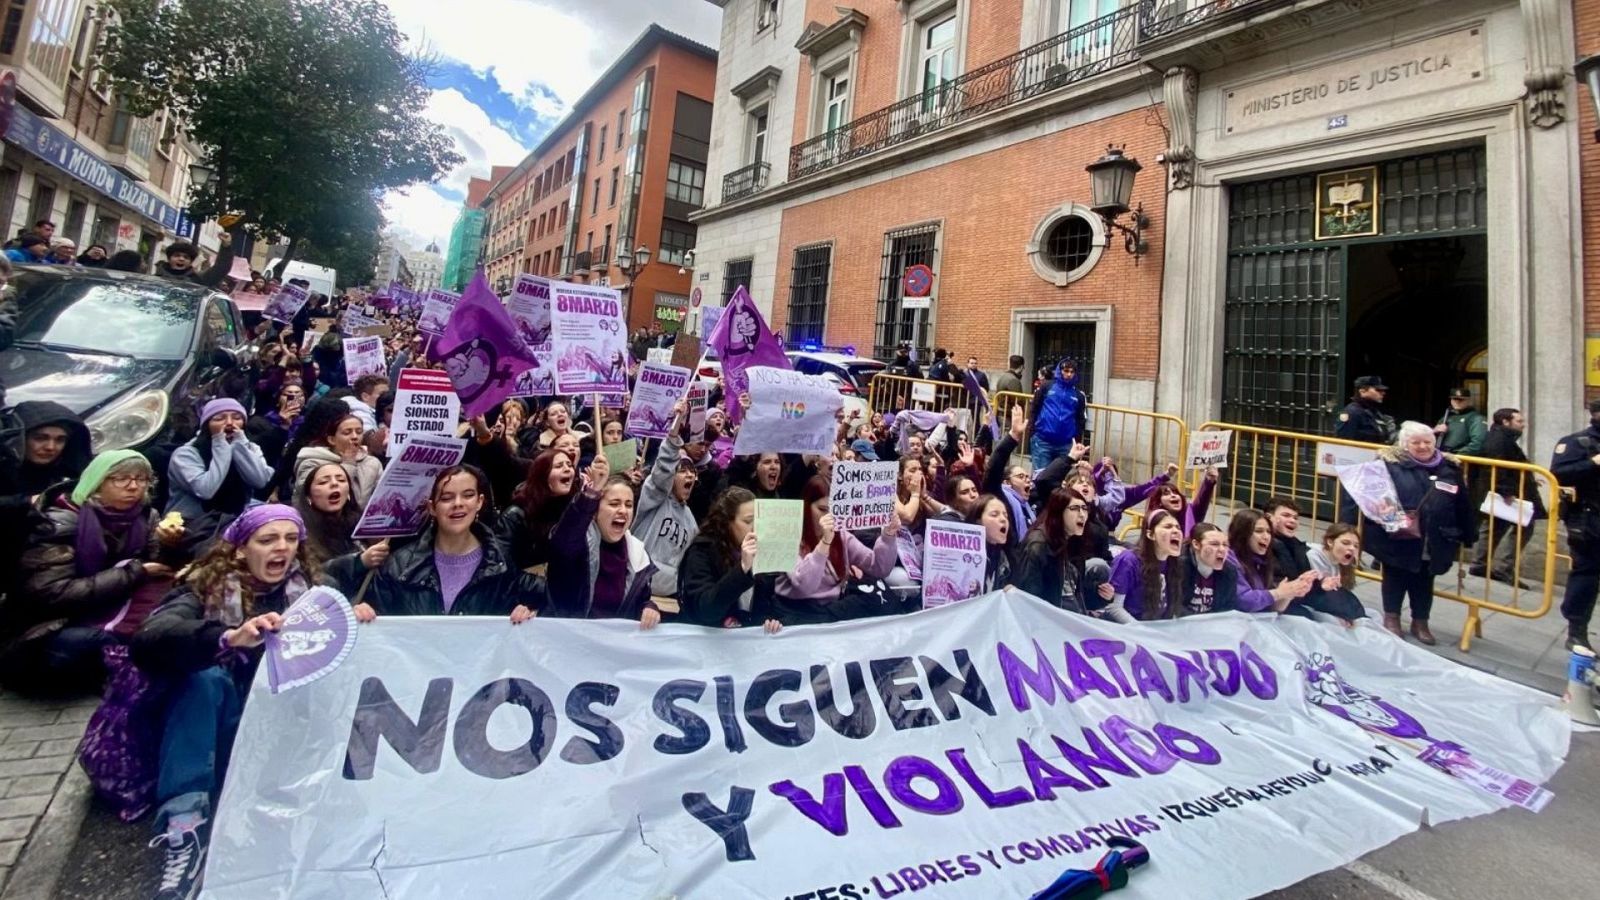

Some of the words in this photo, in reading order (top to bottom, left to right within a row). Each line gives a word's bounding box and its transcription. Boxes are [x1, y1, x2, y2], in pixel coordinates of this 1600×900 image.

[1243, 84, 1329, 118] MINISTERIO
[1337, 75, 1360, 95] DE
[1367, 54, 1451, 91] JUSTICIA
[1328, 116, 1346, 128] 45
[118, 180, 149, 214] BAZAR
[557, 294, 618, 318] 8MARZO
[641, 370, 686, 388] 8MARZO
[410, 394, 447, 405] ESTADO
[405, 407, 449, 419] SIONISTA
[781, 401, 806, 420] NO
[407, 420, 444, 431] ESTADO
[400, 445, 460, 466] 8MARZO
[836, 464, 872, 485] SOMOS
[833, 489, 847, 501] de
[851, 487, 863, 499] las
[832, 503, 850, 515] QUE
[852, 504, 863, 516] NO
[930, 531, 981, 552] 8MARZO
[341, 676, 625, 781] NOS
[650, 648, 998, 755] SIGUEN
[997, 637, 1279, 713] MATANDO
[681, 785, 757, 863] Y
[768, 714, 1221, 837] VIOLANDO
[870, 853, 982, 900] LIBRES
[977, 850, 1002, 870] Y
[1001, 813, 1162, 865] COMBATIVAS
